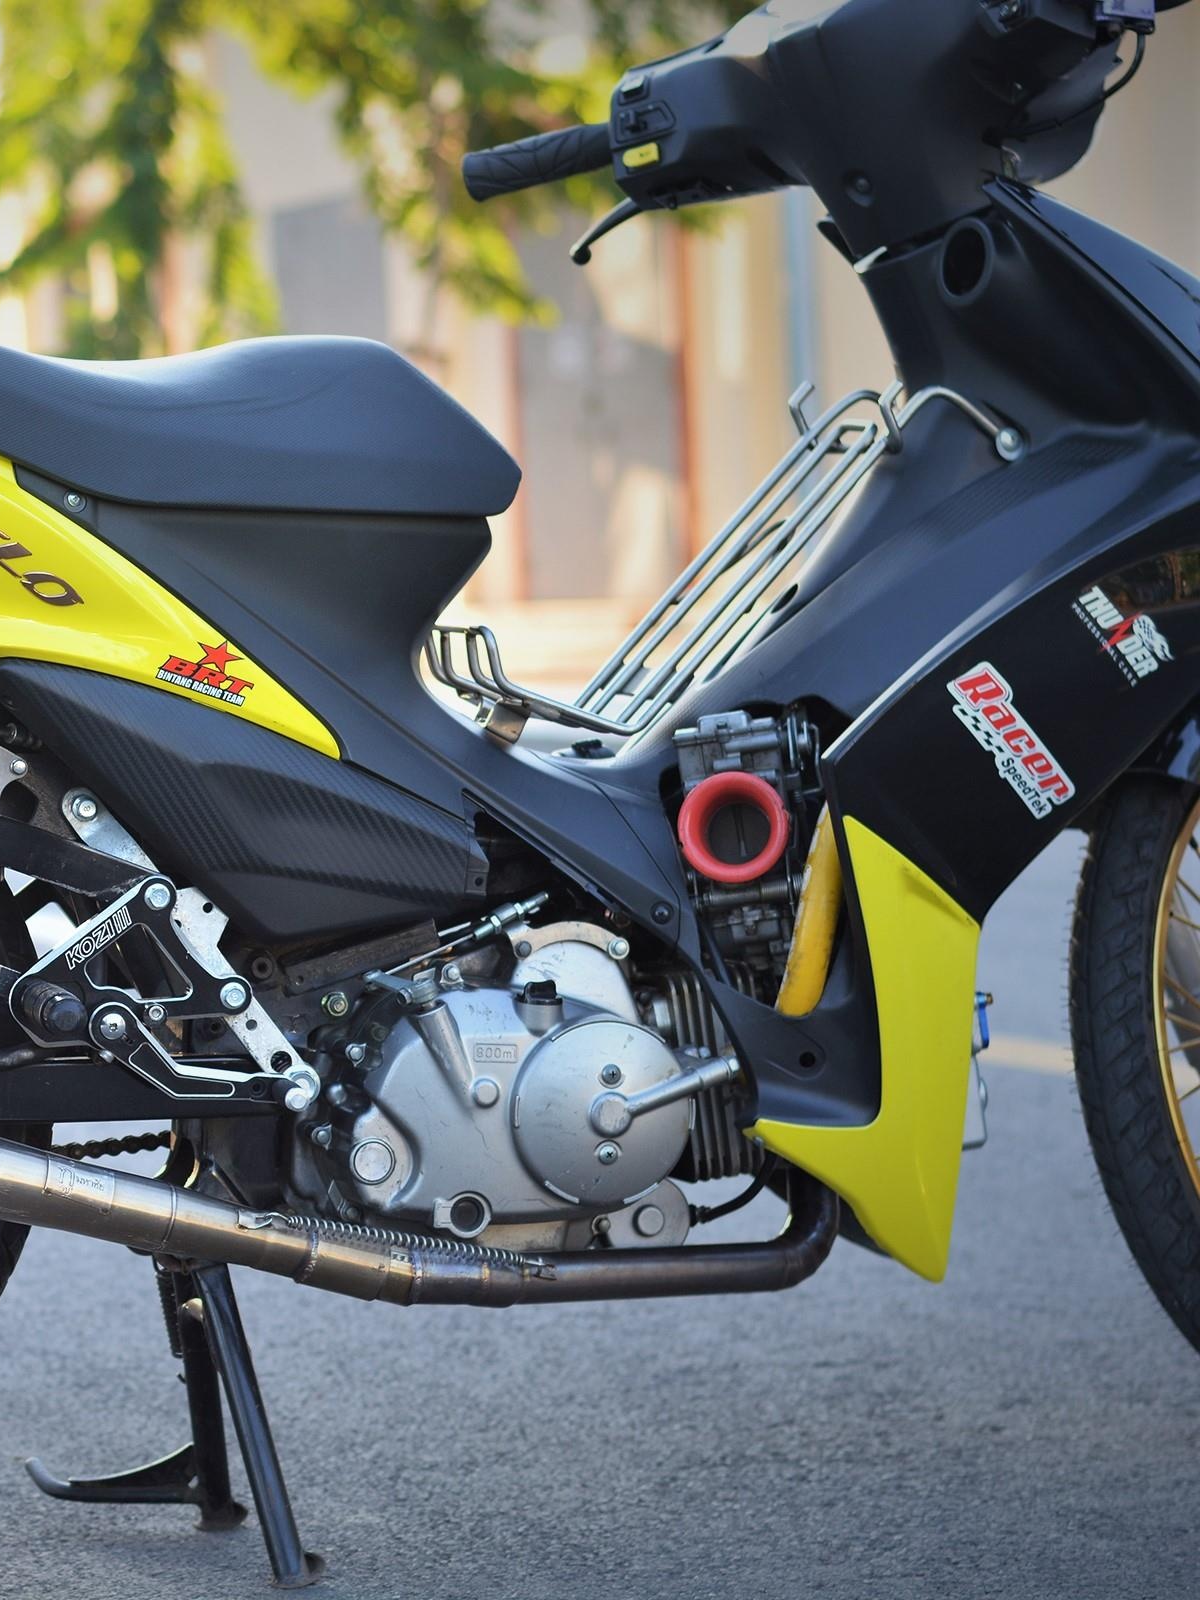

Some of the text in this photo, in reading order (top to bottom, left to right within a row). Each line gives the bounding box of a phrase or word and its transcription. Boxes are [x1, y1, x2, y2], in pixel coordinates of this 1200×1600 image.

[1079, 585, 1158, 678] THUNDER
[157, 669, 245, 706] BINTANG RACING TEAM
[159, 655, 254, 695] BRT
[1118, 660, 1138, 688] CARE
[956, 669, 1070, 799] Racer
[1001, 757, 1048, 815] SpeedTek
